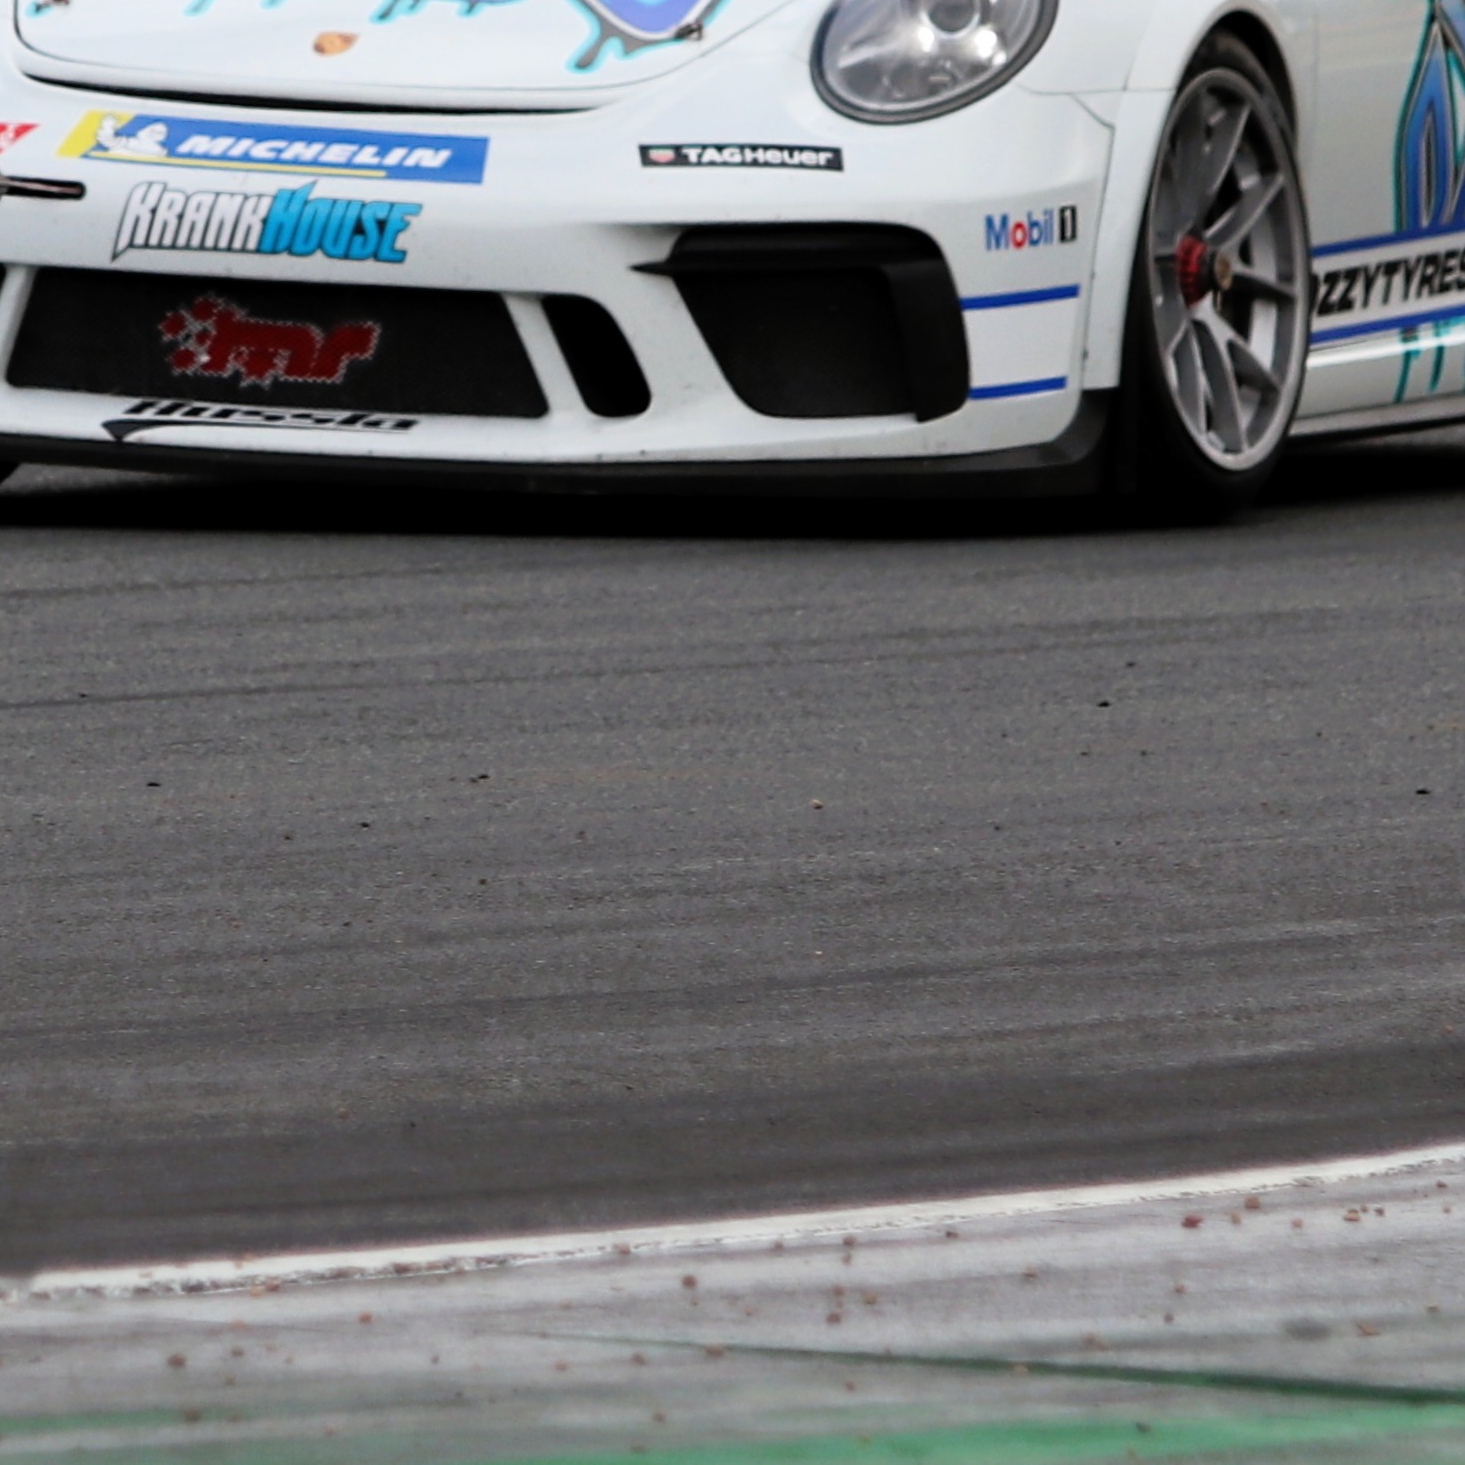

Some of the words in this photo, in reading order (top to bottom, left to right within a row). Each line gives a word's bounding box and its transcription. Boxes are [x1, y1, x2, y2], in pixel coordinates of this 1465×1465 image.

[176, 134, 451, 168] MICHELIN
[985, 209, 1054, 251] Mobil
[1059, 206, 1077, 243] 1
